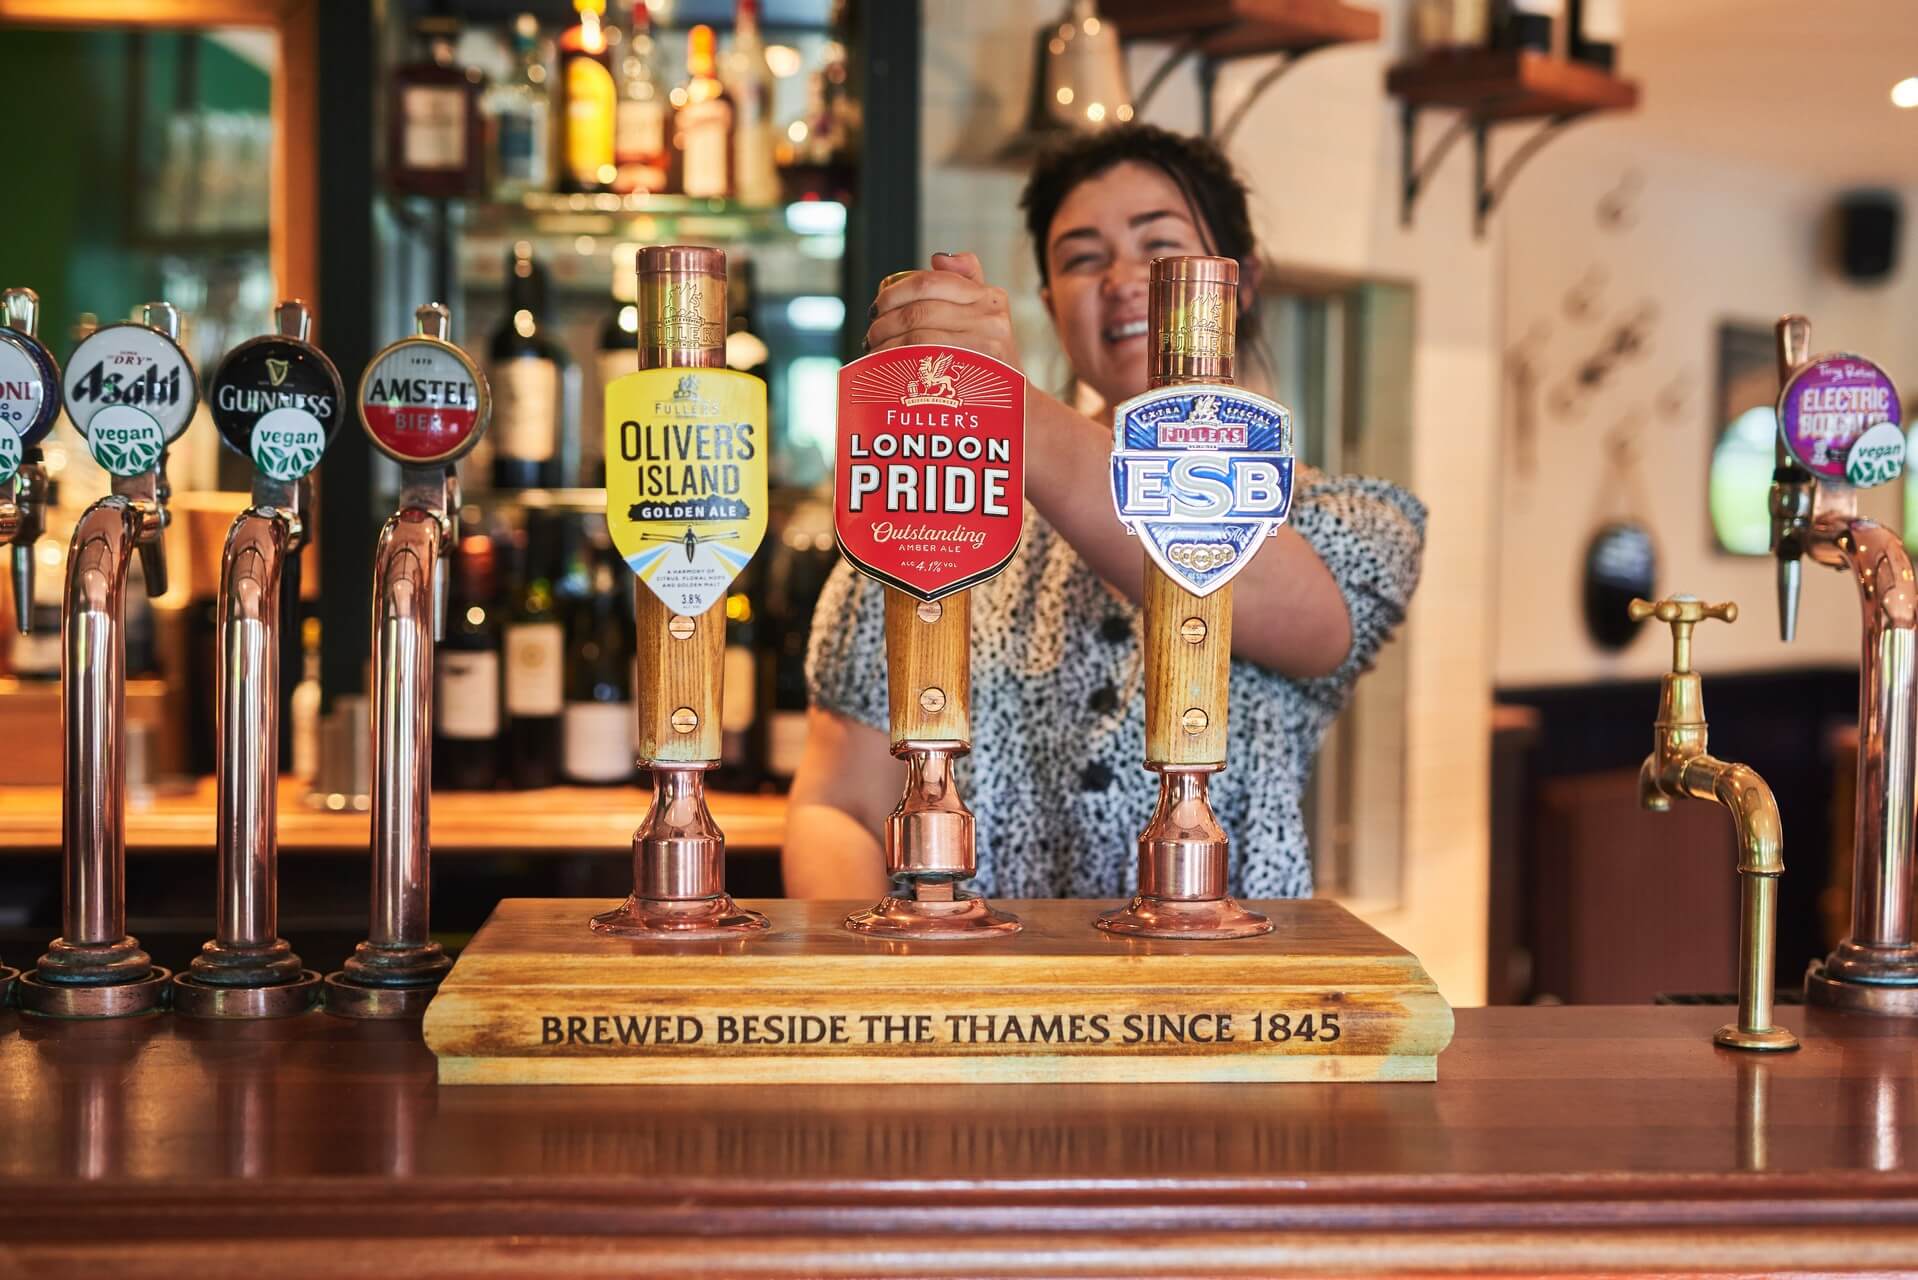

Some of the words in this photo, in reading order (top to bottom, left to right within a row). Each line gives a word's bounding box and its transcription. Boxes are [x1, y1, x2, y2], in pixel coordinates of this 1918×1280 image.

[71, 359, 180, 406] Asahi
[369, 378, 468, 405] AMSTEL
[1803, 386, 1889, 411] ELECTRIC
[396, 413, 442, 432] BIER
[887, 409, 979, 430] FULLER'S
[1140, 406, 1181, 421] EXTRA
[1226, 407, 1272, 425] SPECIAL
[95, 427, 154, 444] vegan
[260, 430, 318, 447] vegan
[620, 420, 755, 462] OLIVER'S
[1166, 427, 1242, 442] FULLER'S
[850, 433, 1010, 464] LONDON
[1859, 444, 1901, 459] vegan
[638, 464, 740, 497] ISLAND
[849, 463, 1010, 517] PRIDE
[1122, 455, 1284, 519] ESB
[641, 506, 705, 519] GOLDEN
[709, 505, 737, 518] ALE
[871, 521, 987, 550] Outstanding
[898, 543, 936, 552] AMBER
[940, 545, 961, 553] ALE
[915, 560, 942, 573] 4.1%
[541, 1015, 703, 1046] BREWED
[716, 1015, 849, 1045] BESIDE
[859, 1015, 935, 1044] THE
[944, 1014, 1110, 1044] THAMES
[1122, 1013, 1235, 1044] SINCE
[1251, 1011, 1341, 1043] 1845
